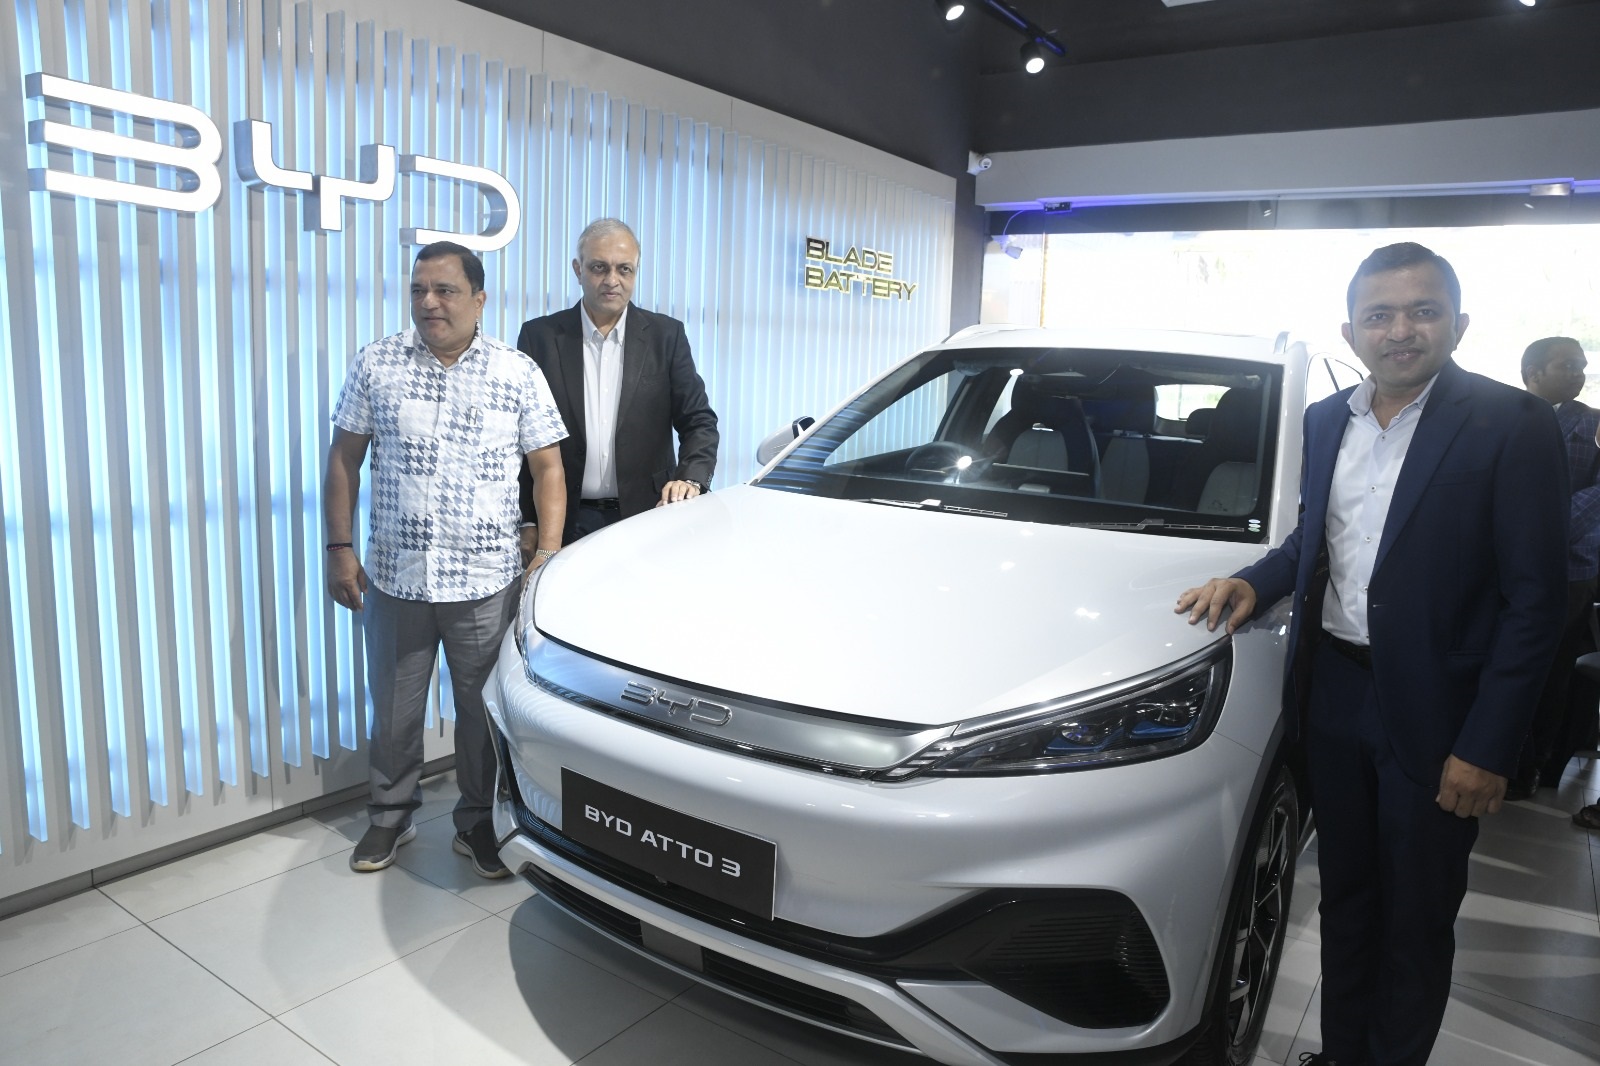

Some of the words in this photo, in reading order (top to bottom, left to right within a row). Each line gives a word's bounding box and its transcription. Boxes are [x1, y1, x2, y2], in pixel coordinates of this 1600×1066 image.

[25, 72, 521, 252] BYD
[806, 236, 893, 275] BLADE
[805, 264, 918, 301] BATTERY
[620, 680, 733, 727] BYD
[584, 804, 632, 837] BYD
[640, 829, 714, 868] ATTO
[721, 857, 741, 878] 3
